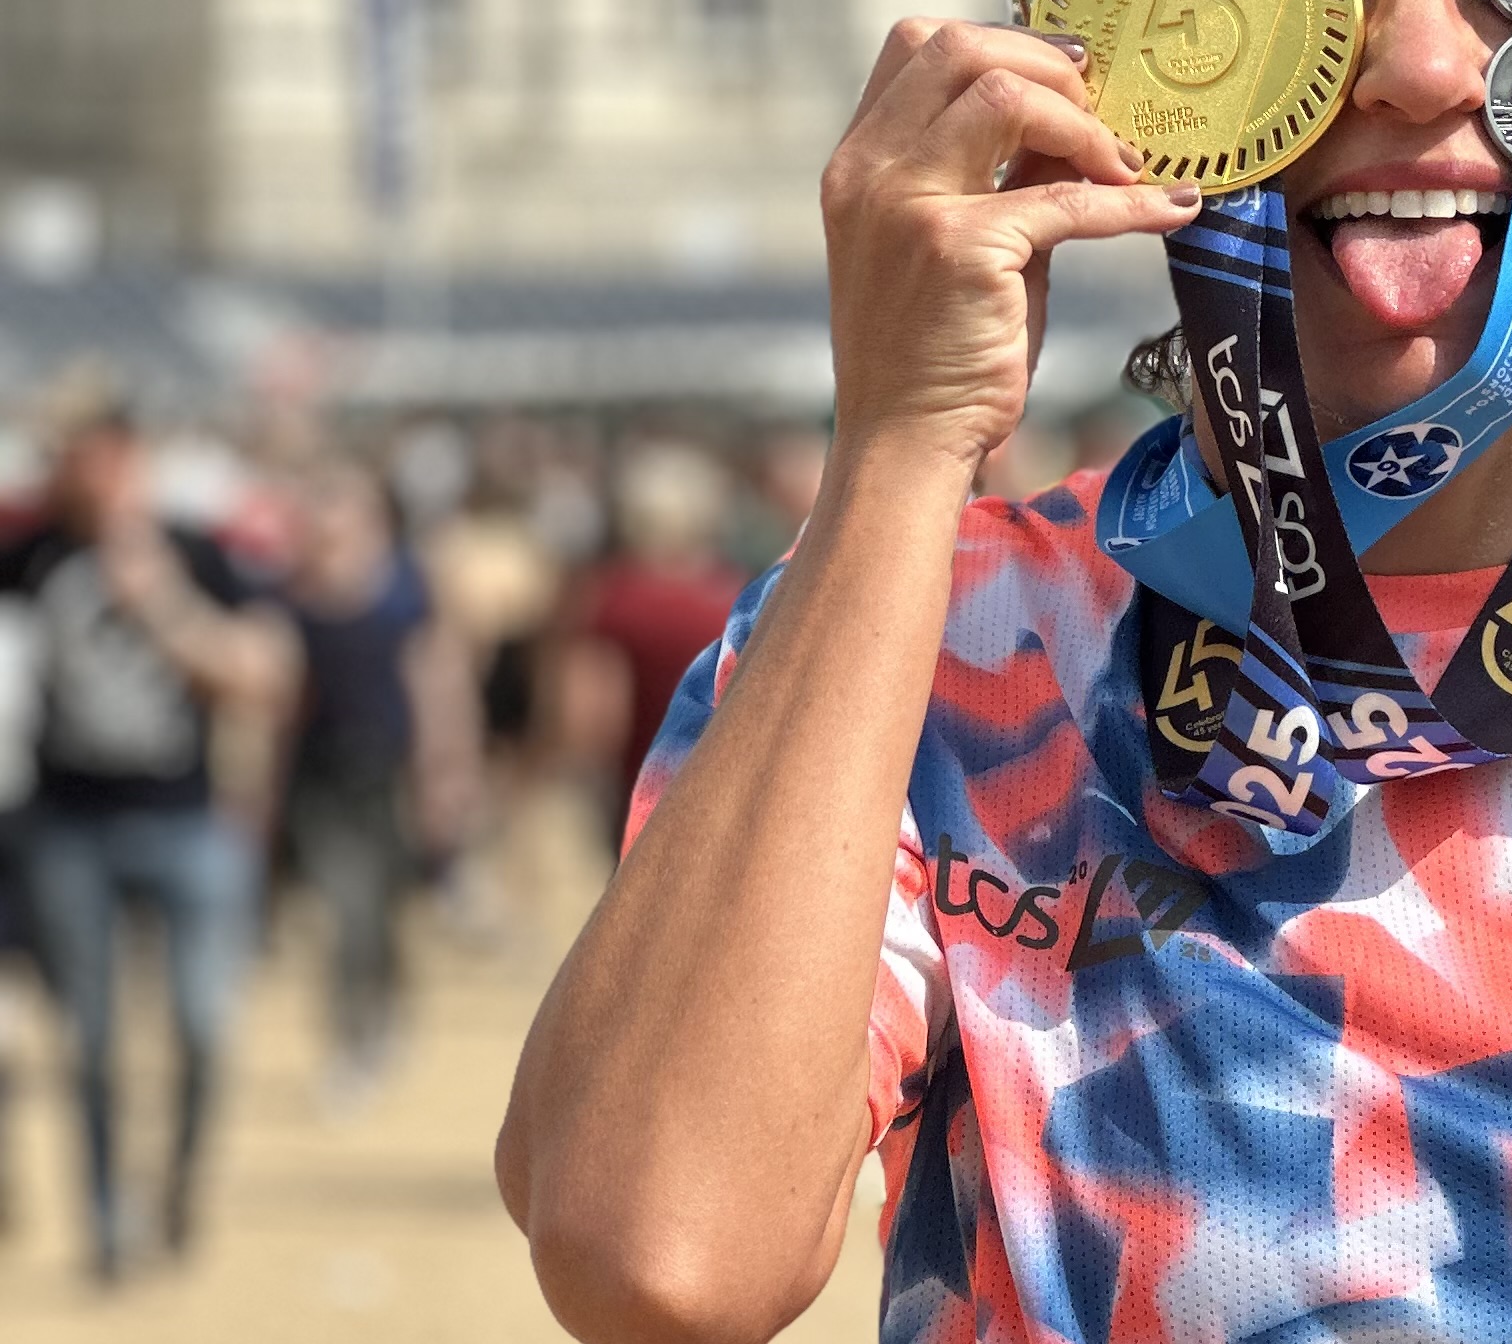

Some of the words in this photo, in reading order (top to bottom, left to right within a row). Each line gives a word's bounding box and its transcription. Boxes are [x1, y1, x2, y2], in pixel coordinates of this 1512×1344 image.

[1130, 100, 1153, 115] WE
[1132, 106, 1194, 127] FINISHED
[1133, 116, 1208, 140] TOGETHER
[1207, 334, 1253, 448] tcs
[1273, 491, 1327, 603] tcs
[935, 832, 1061, 950] tcs
[1068, 860, 1088, 885] 20
